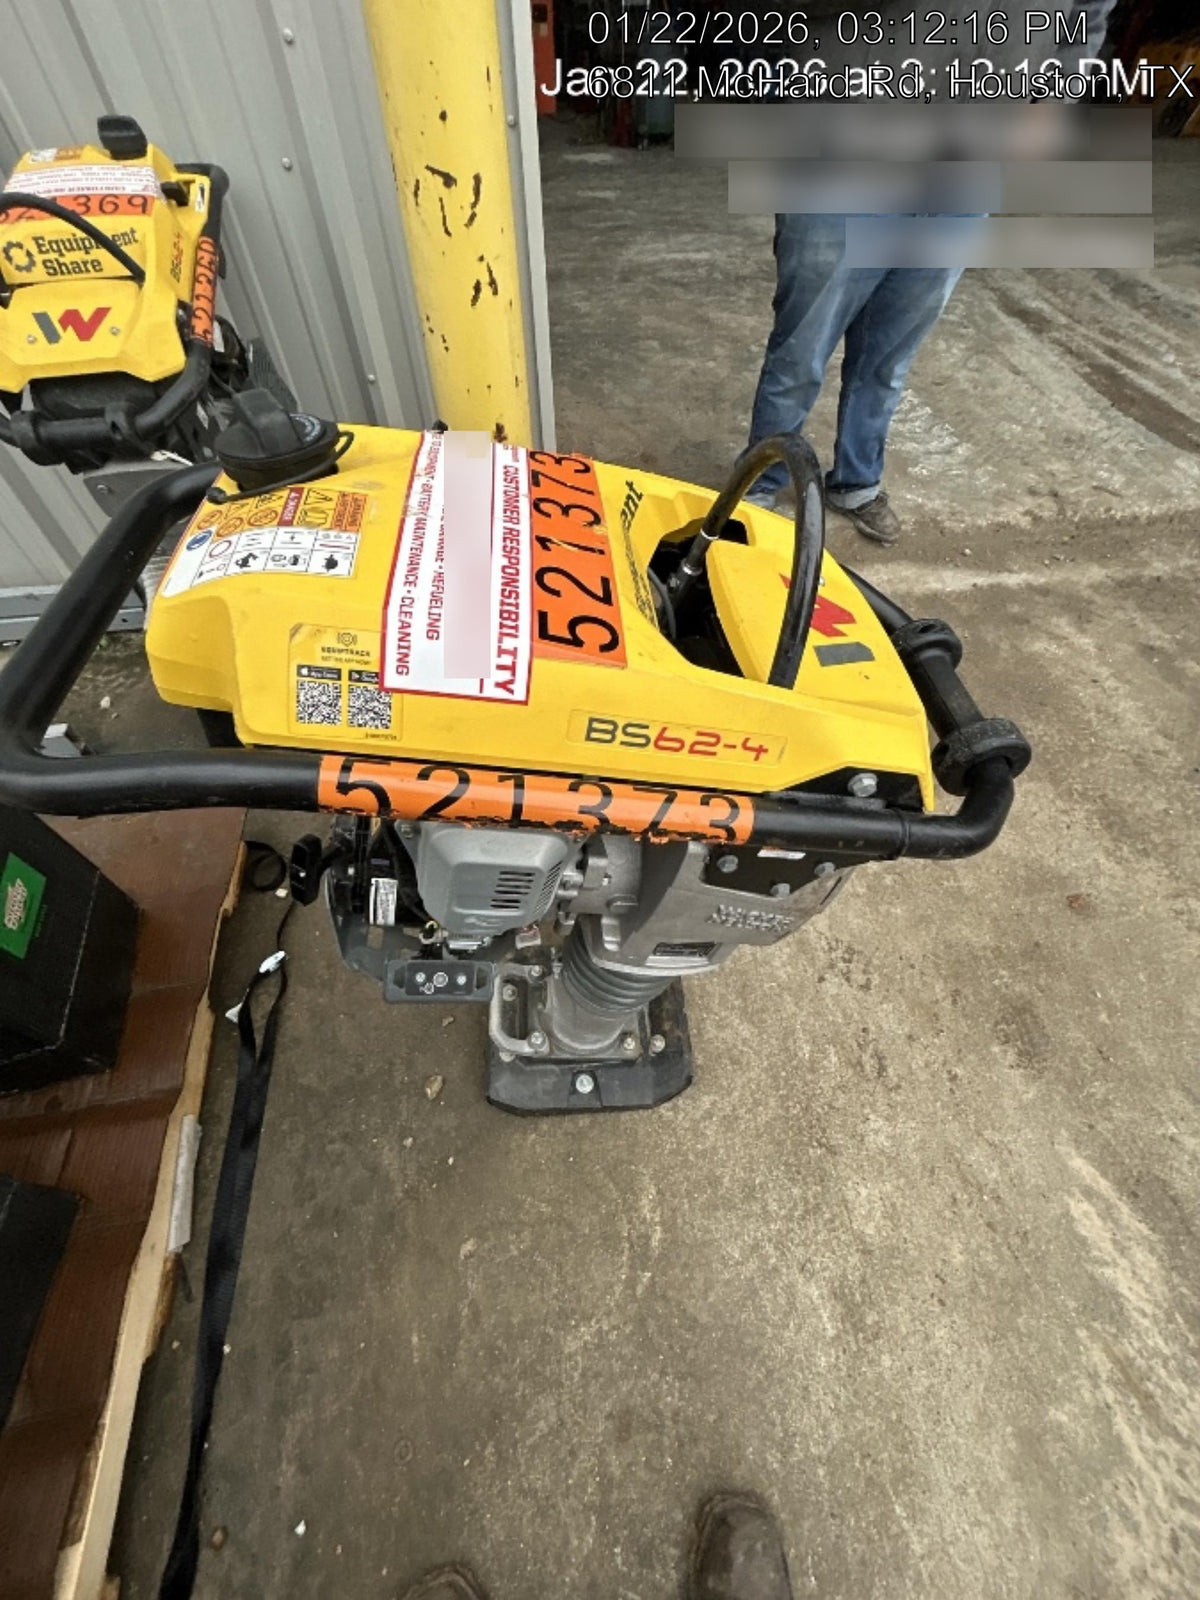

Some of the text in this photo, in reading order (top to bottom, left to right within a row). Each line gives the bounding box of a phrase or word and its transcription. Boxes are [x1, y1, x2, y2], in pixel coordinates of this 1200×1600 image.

[32, 227, 139, 258] Equipent
[42, 257, 104, 277] Share
[502, 465, 521, 524] CUSTOMER
[403, 517, 428, 588] MAINTENANCE
[529, 450, 620, 654] 521373
[395, 596, 415, 677] CLEANING
[425, 570, 445, 641] REFUELING
[494, 527, 521, 696] RESPONSIBILITY
[584, 716, 769, 762] BS62-4
[336, 756, 741, 841] 521373
